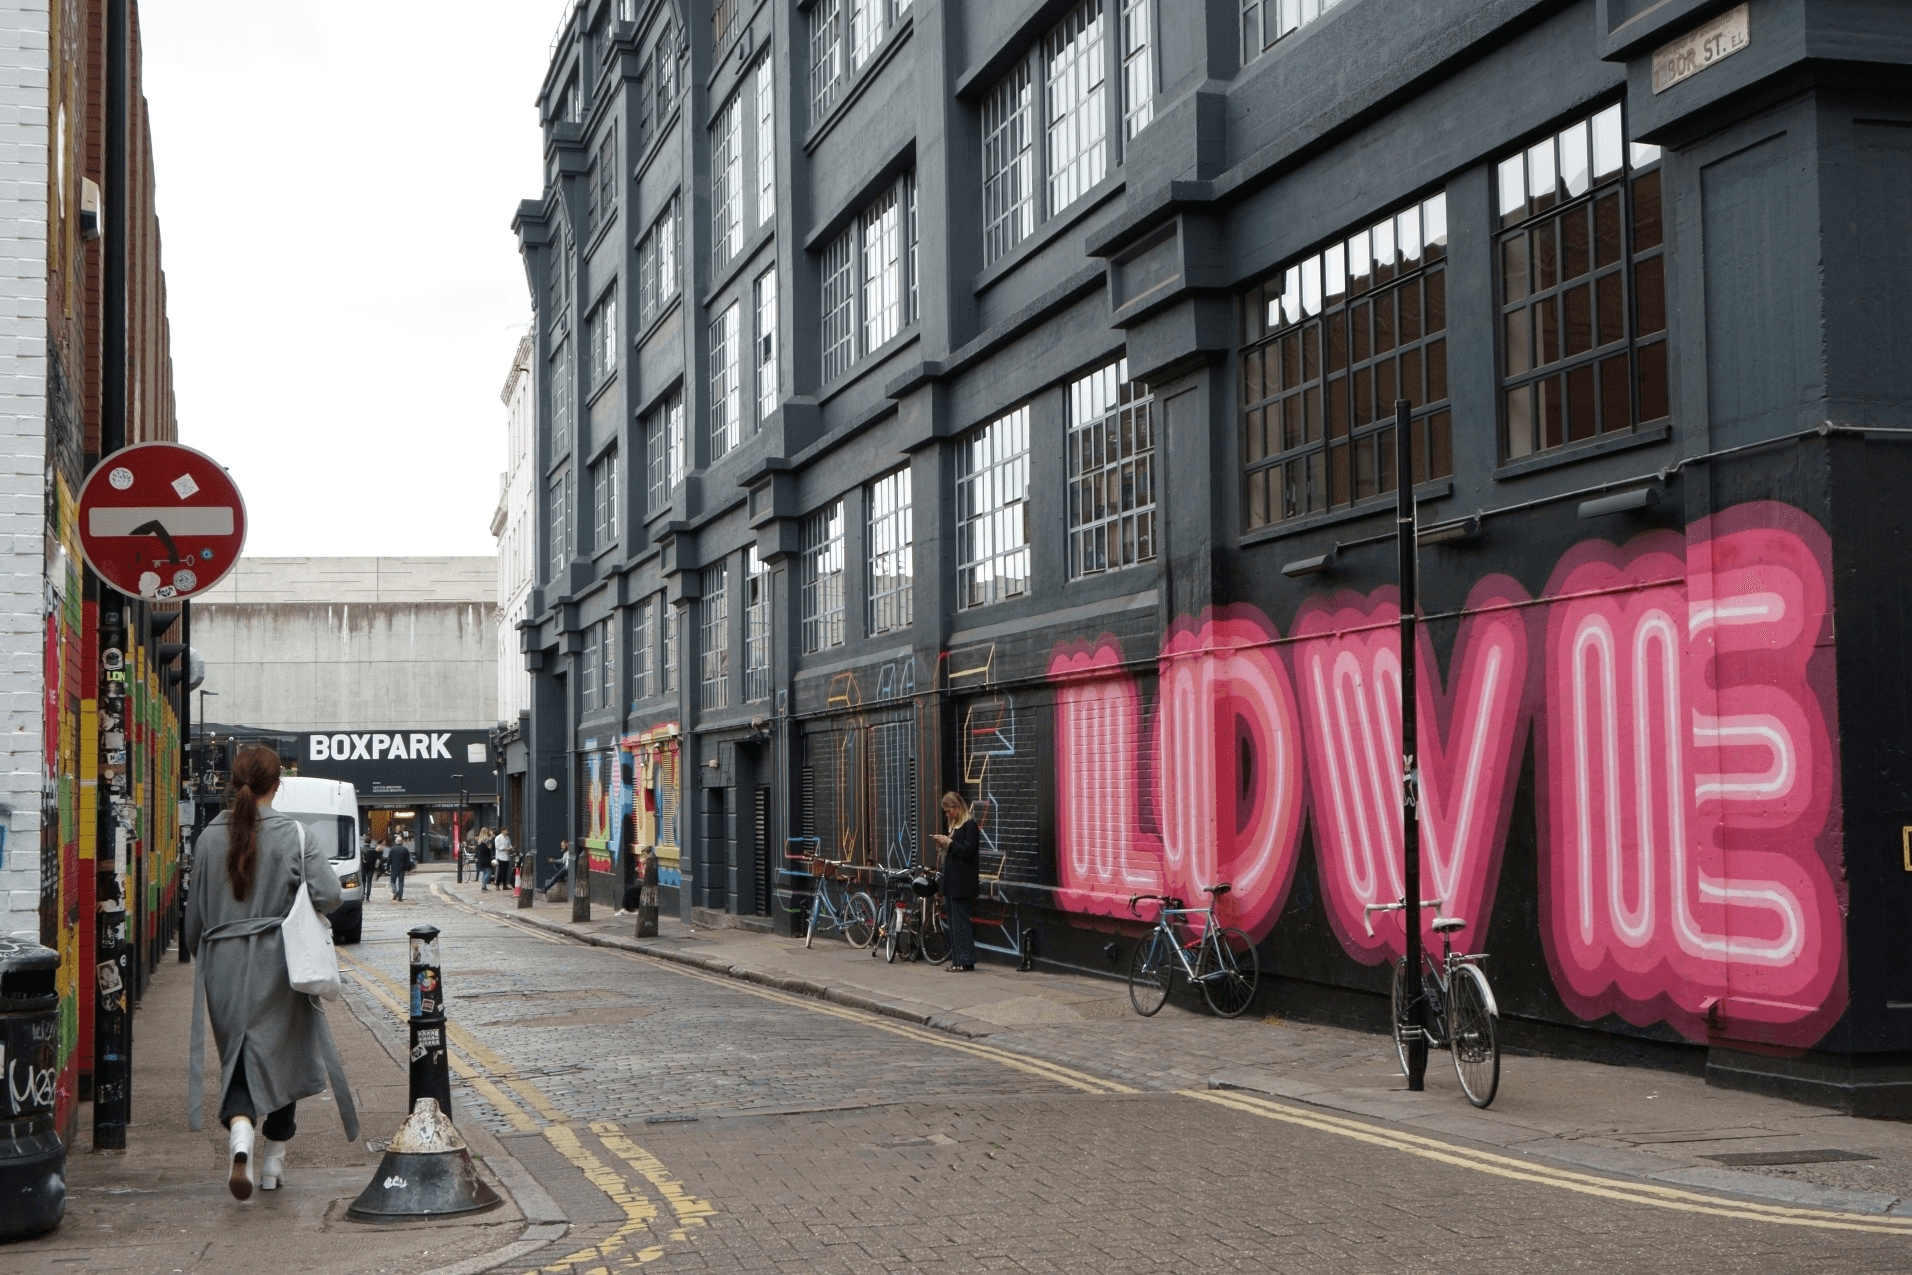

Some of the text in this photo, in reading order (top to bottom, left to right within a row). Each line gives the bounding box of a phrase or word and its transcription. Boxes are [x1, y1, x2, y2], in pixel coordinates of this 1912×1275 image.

[1703, 32, 1726, 62] ST.
[309, 733, 452, 760] BOXPARK
[1050, 502, 1848, 1047] LOVE
